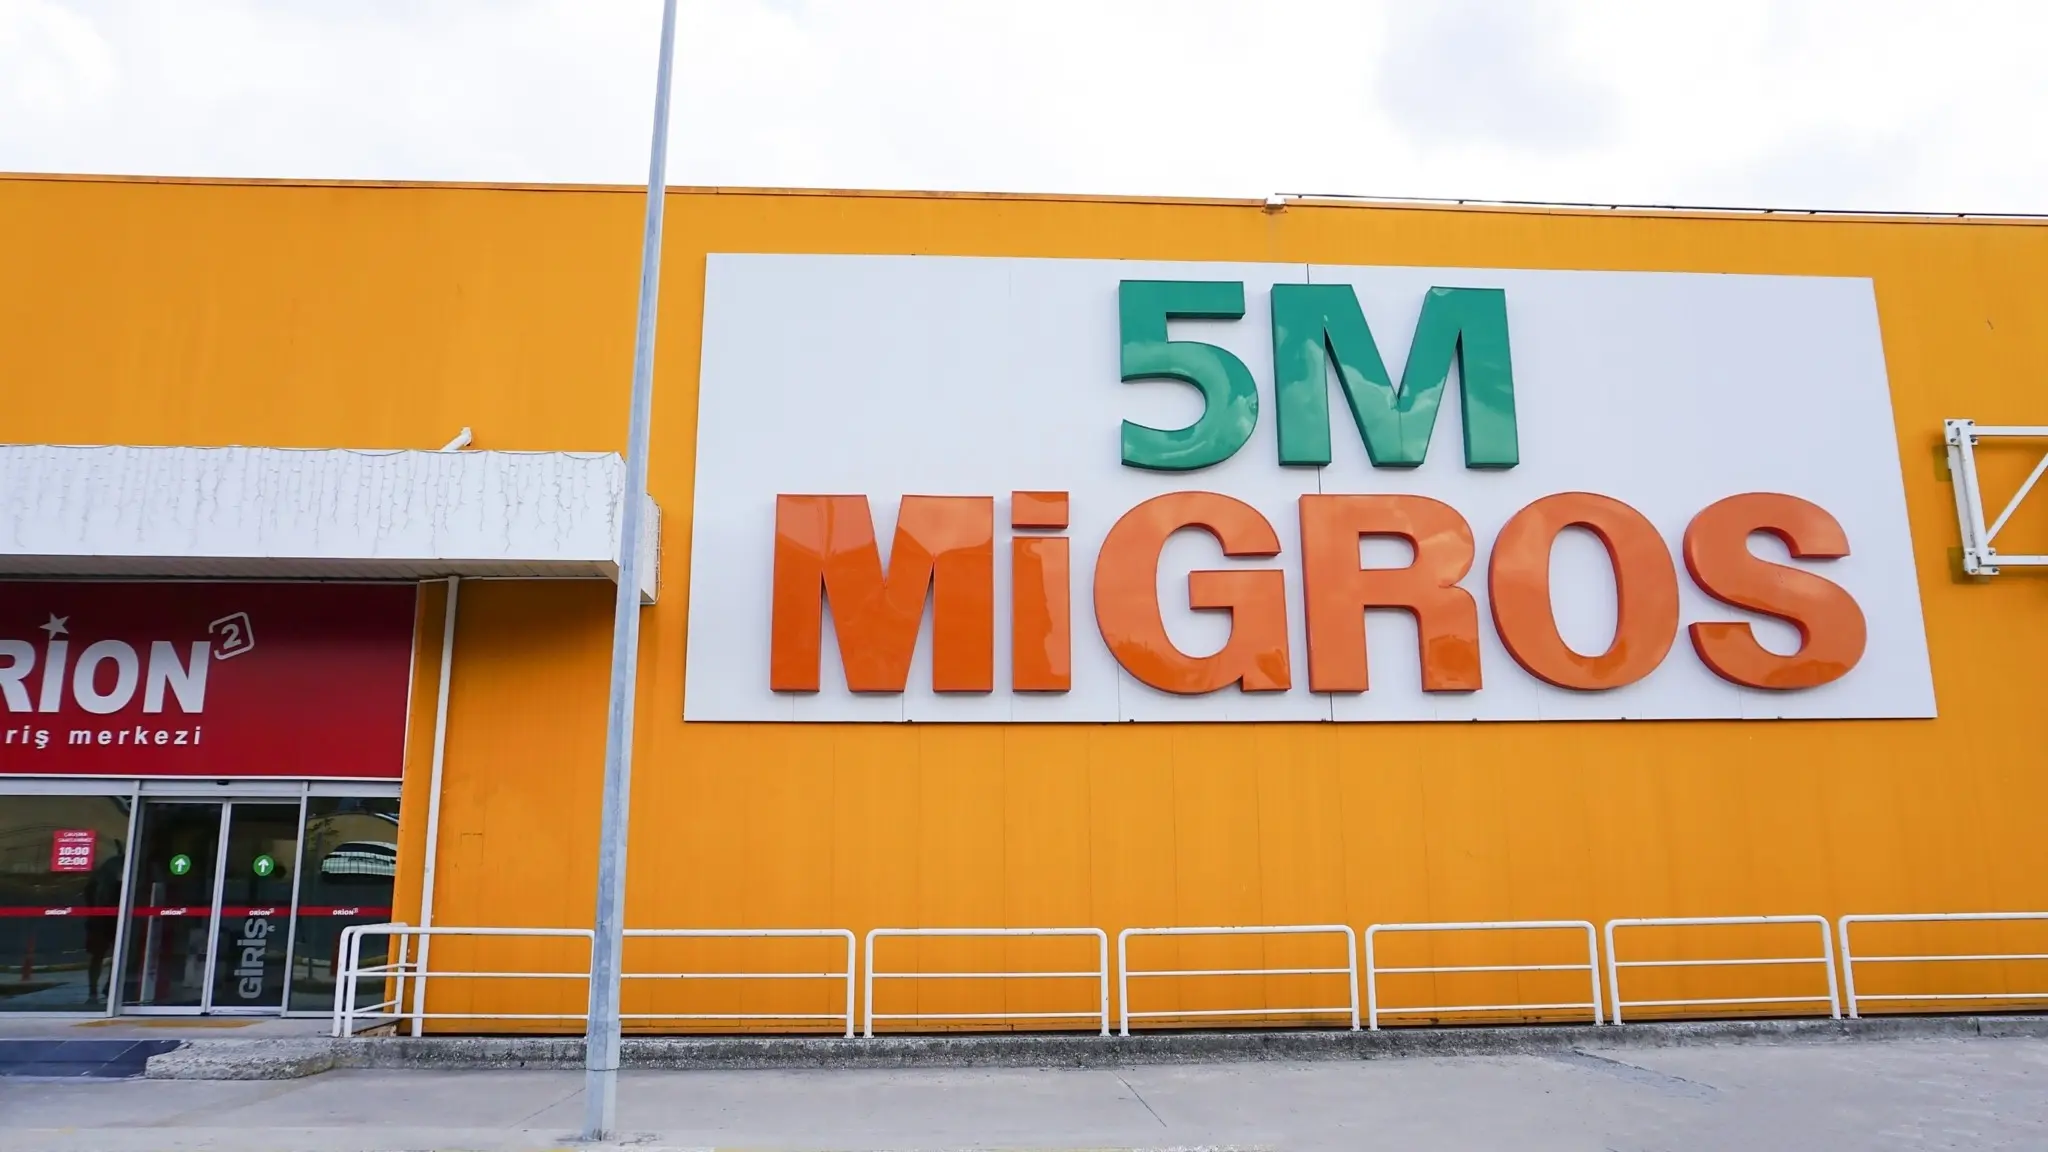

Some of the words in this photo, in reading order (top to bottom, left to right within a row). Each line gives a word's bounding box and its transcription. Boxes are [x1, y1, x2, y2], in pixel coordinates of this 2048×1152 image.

[1118, 279, 1520, 471] 5M
[68, 726, 201, 745] merkezi
[58, 846, 90, 856] 10:00
[57, 856, 88, 866] 22:00
